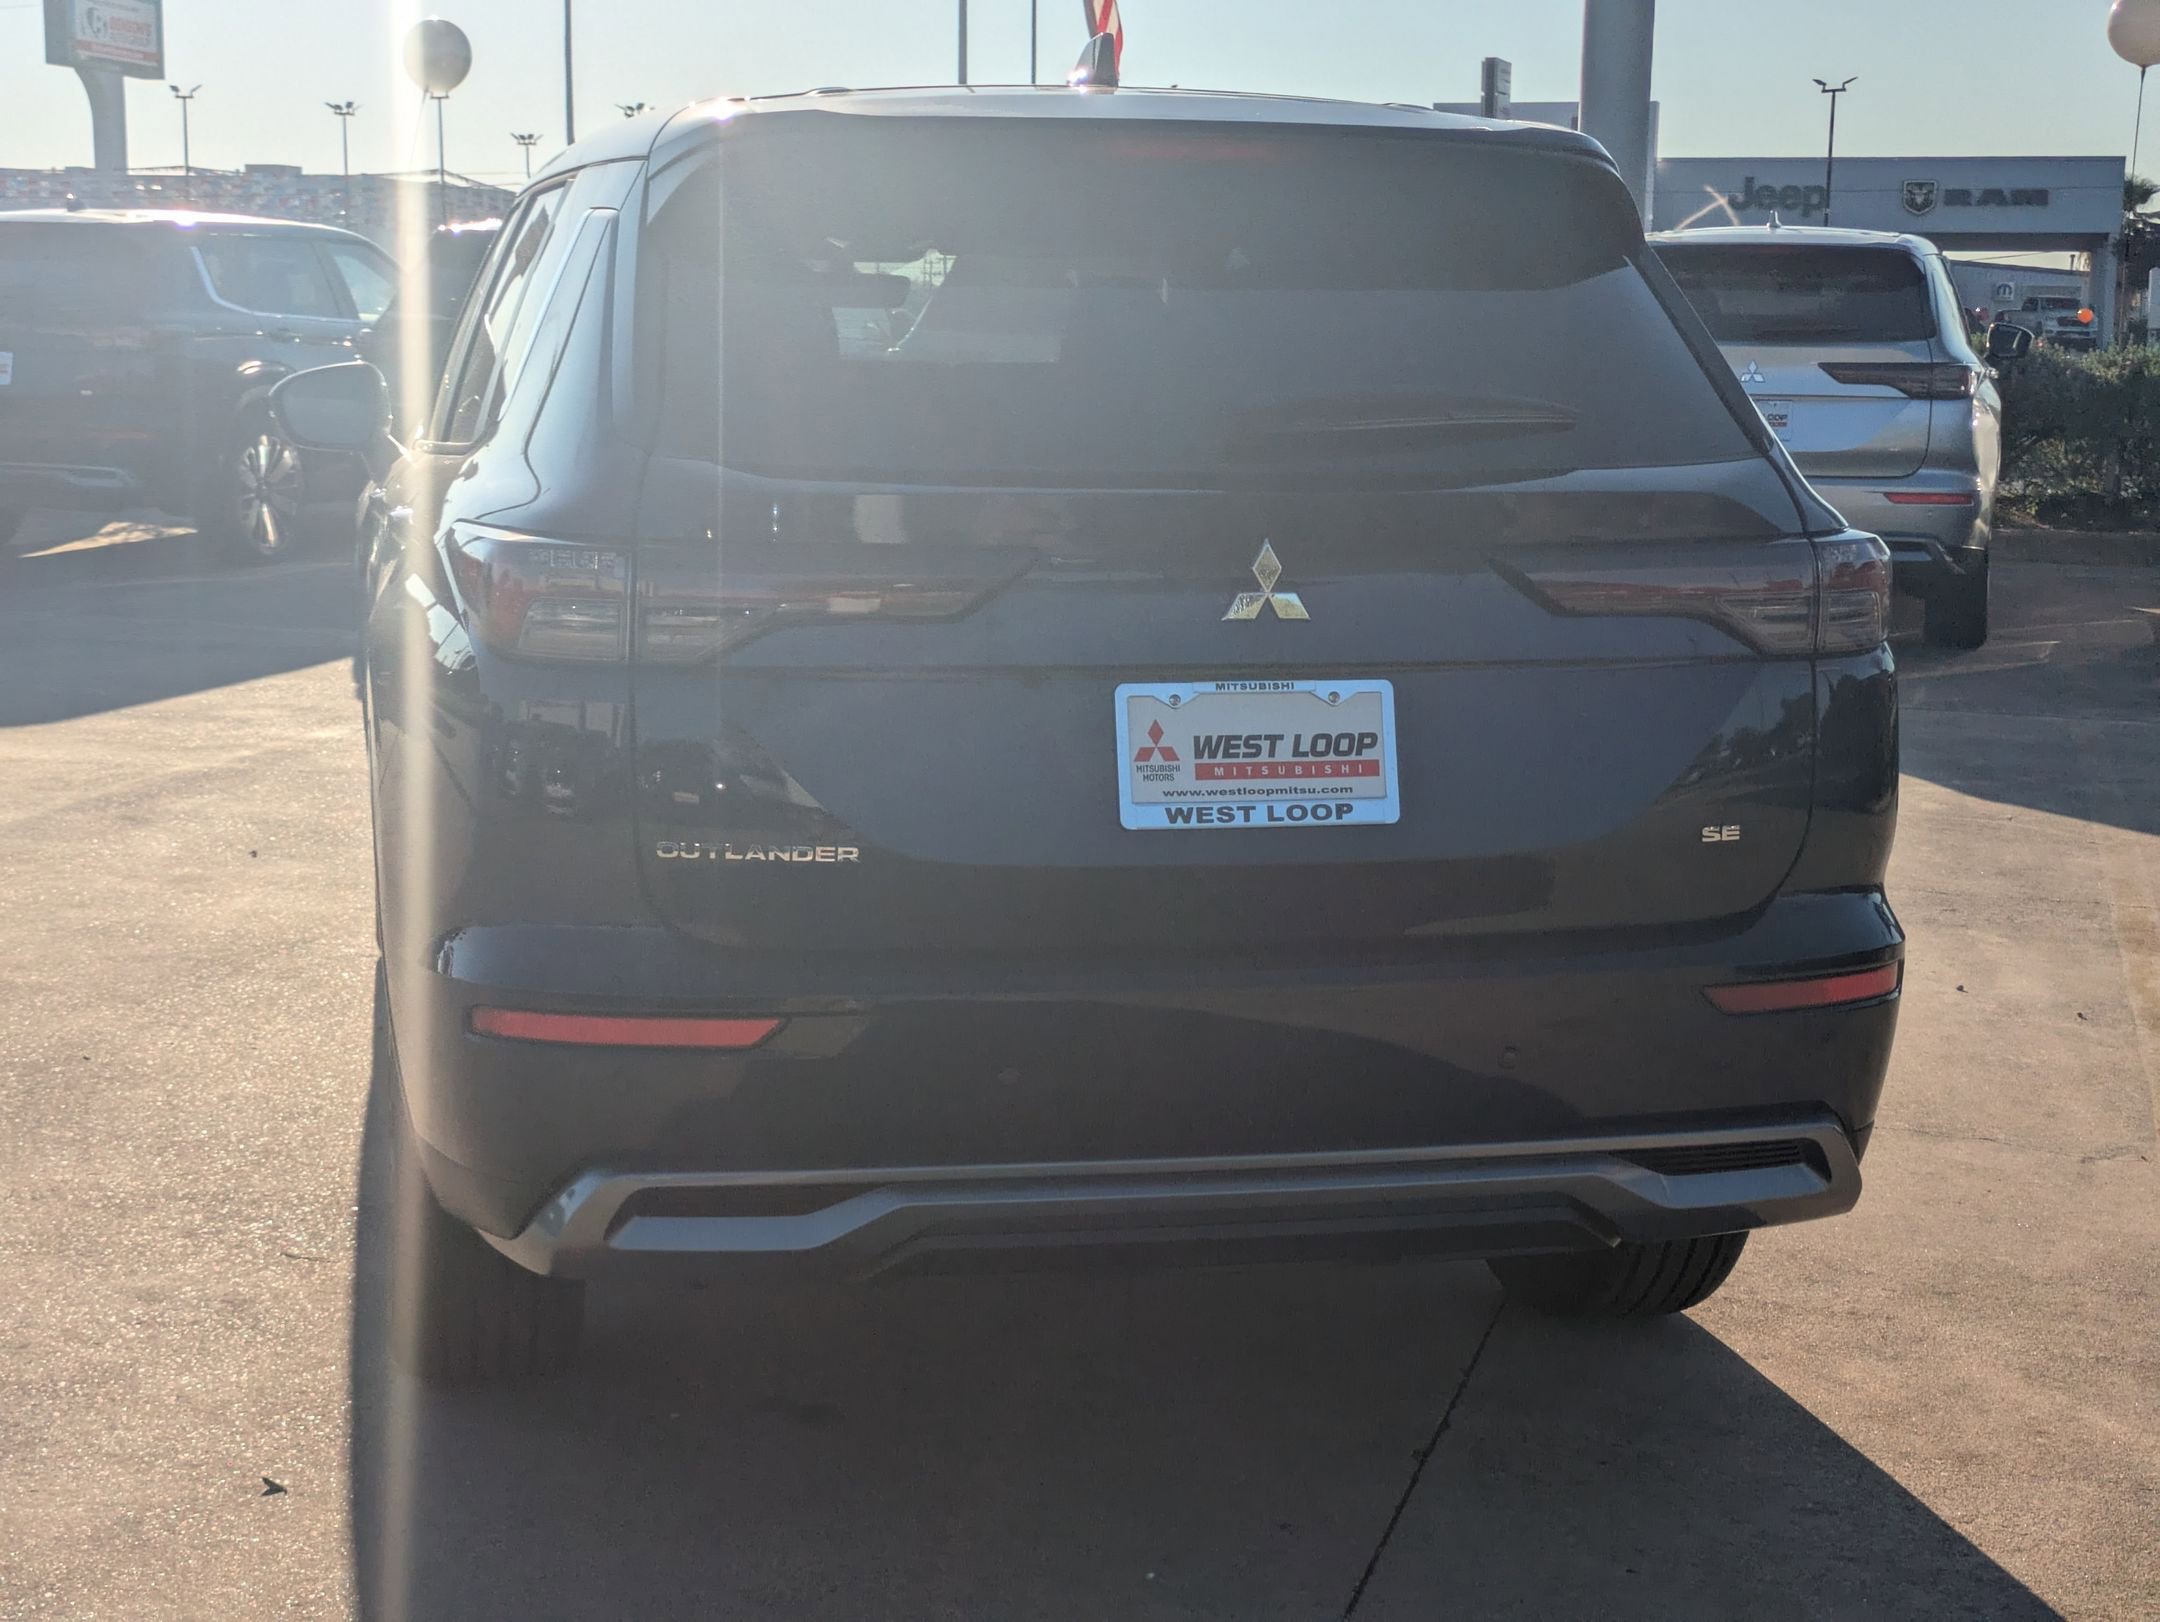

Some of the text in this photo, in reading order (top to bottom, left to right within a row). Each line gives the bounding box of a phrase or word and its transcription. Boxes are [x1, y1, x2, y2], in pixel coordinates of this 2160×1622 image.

[1727, 176, 1826, 217] Jeep
[1944, 188, 2049, 206] RAM
[1215, 682, 1295, 691] MITSUBISHI
[1193, 732, 1378, 759] WEST LOOP
[1136, 764, 1180, 773] MITSUBISHI
[1214, 763, 1362, 776] MITSUBISHI
[1143, 773, 1175, 782] MOTORS
[1162, 786, 1353, 797] www.westloopmitsu.com
[1164, 803, 1354, 824] WEST LOOP
[1702, 825, 1740, 842] SE
[656, 841, 861, 863] OUTLANDER
